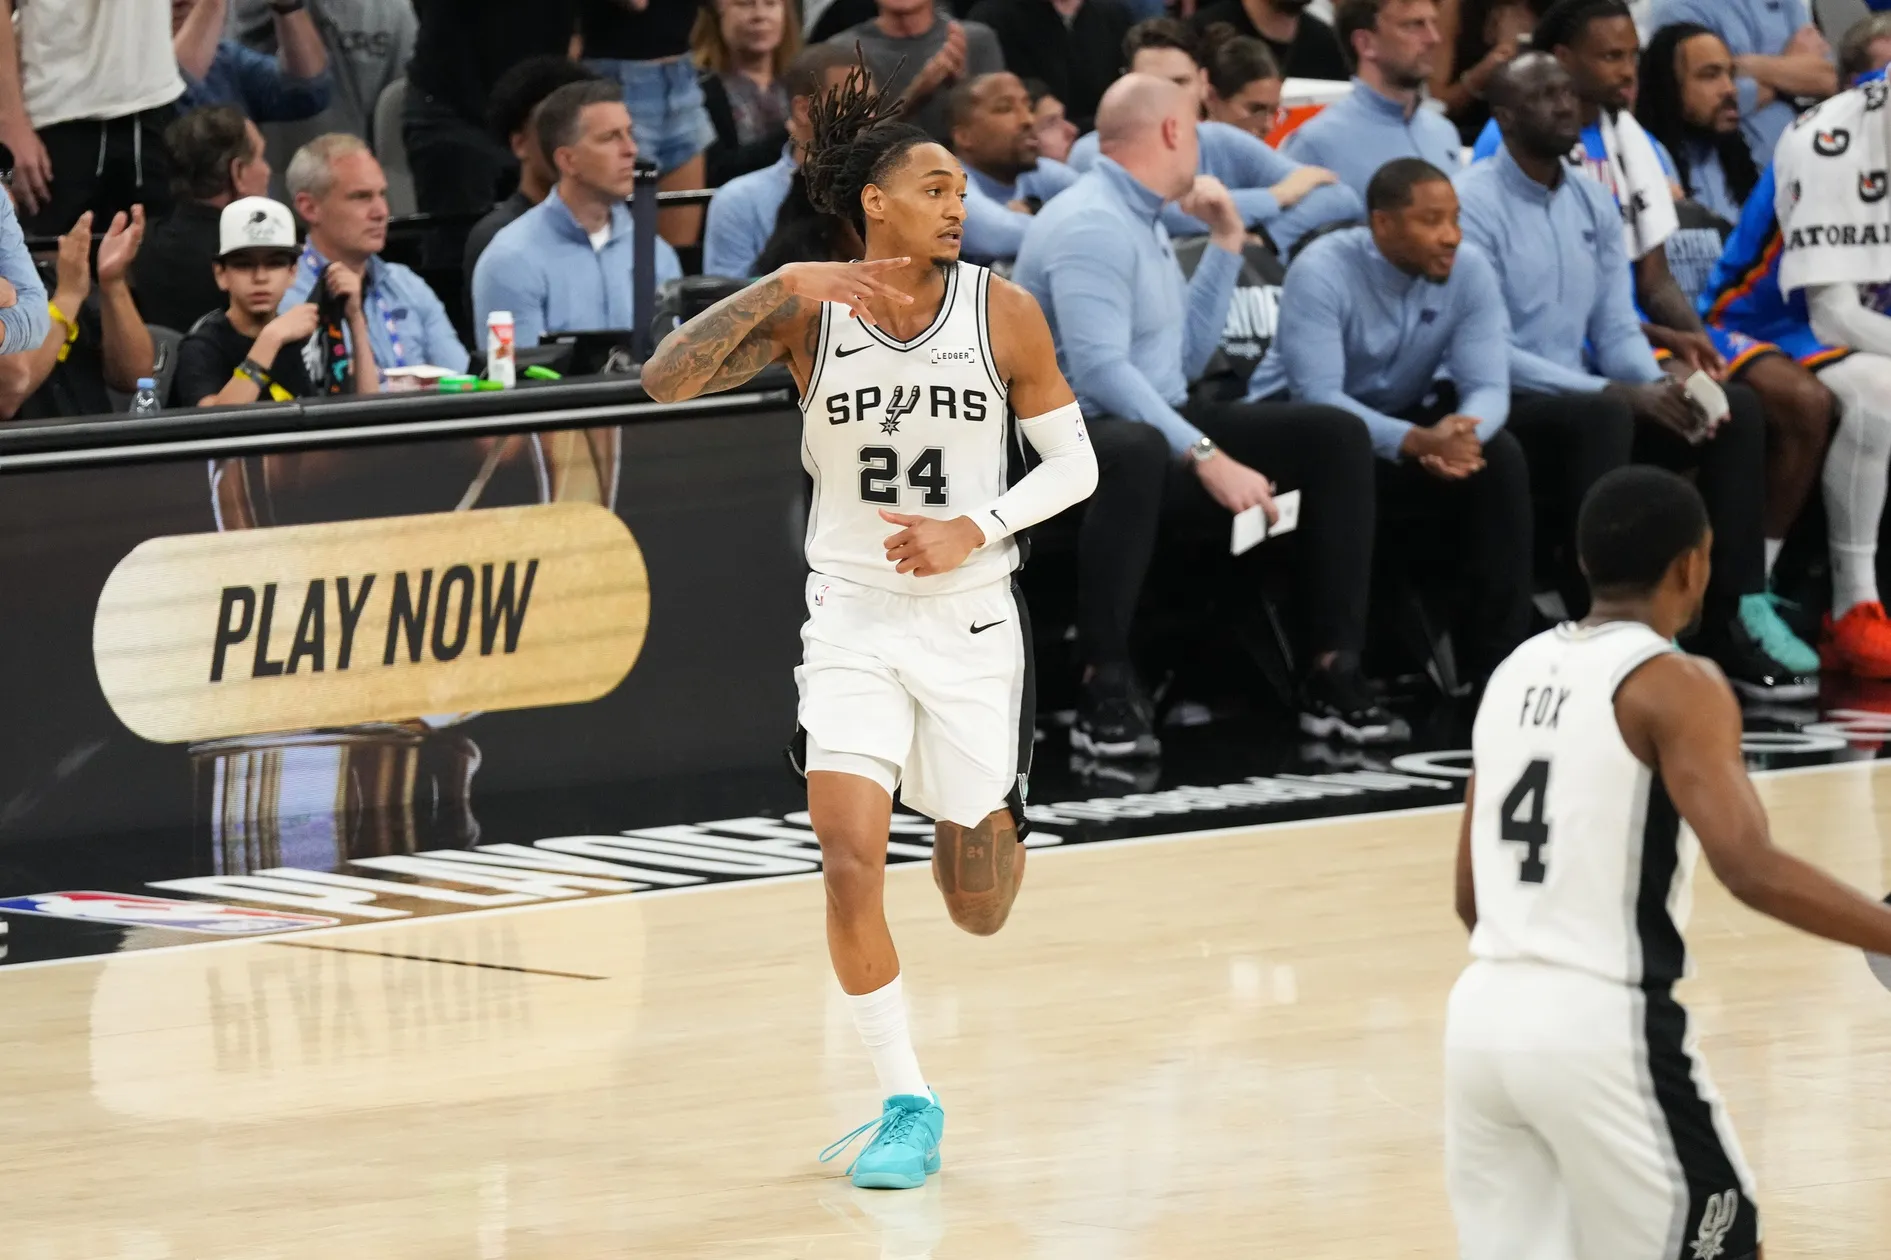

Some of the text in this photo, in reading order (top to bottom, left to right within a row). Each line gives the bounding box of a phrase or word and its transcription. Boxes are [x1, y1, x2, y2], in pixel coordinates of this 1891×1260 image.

[1786, 224, 1891, 250] ATORA
[936, 351, 970, 361] LEDGER
[826, 385, 987, 435] SPURS
[858, 444, 949, 507] 24
[209, 559, 539, 682] PLAY NOW
[1519, 685, 1571, 729] FOX
[1500, 758, 1551, 884] 4
